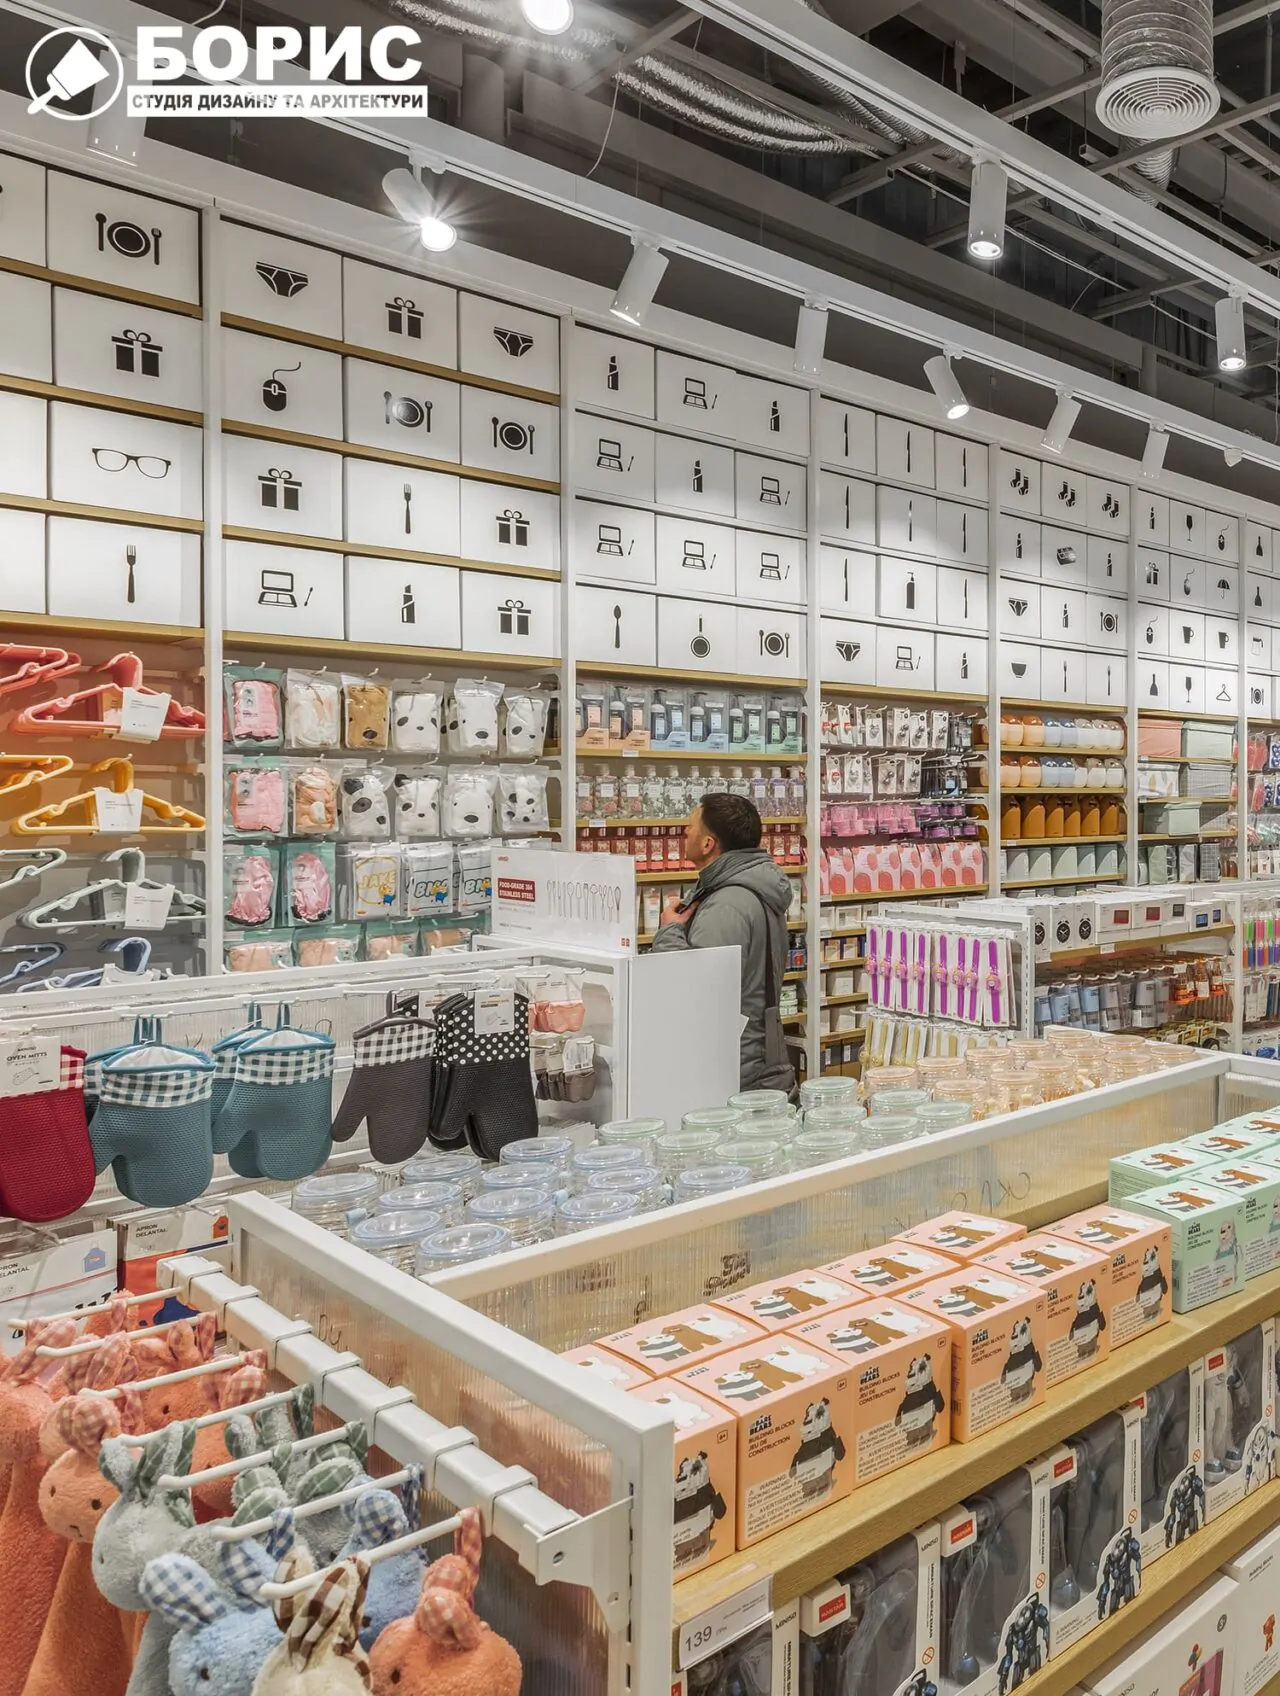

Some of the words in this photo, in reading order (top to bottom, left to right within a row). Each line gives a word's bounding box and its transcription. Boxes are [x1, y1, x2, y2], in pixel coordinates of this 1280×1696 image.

[135, 1227, 167, 1238] DELANTAL
[136, 1223, 158, 1232] APRON
[0, 1263, 18, 1271] PRON
[0, 1266, 30, 1278] ELANTAL
[685, 1625, 712, 1652] 139
